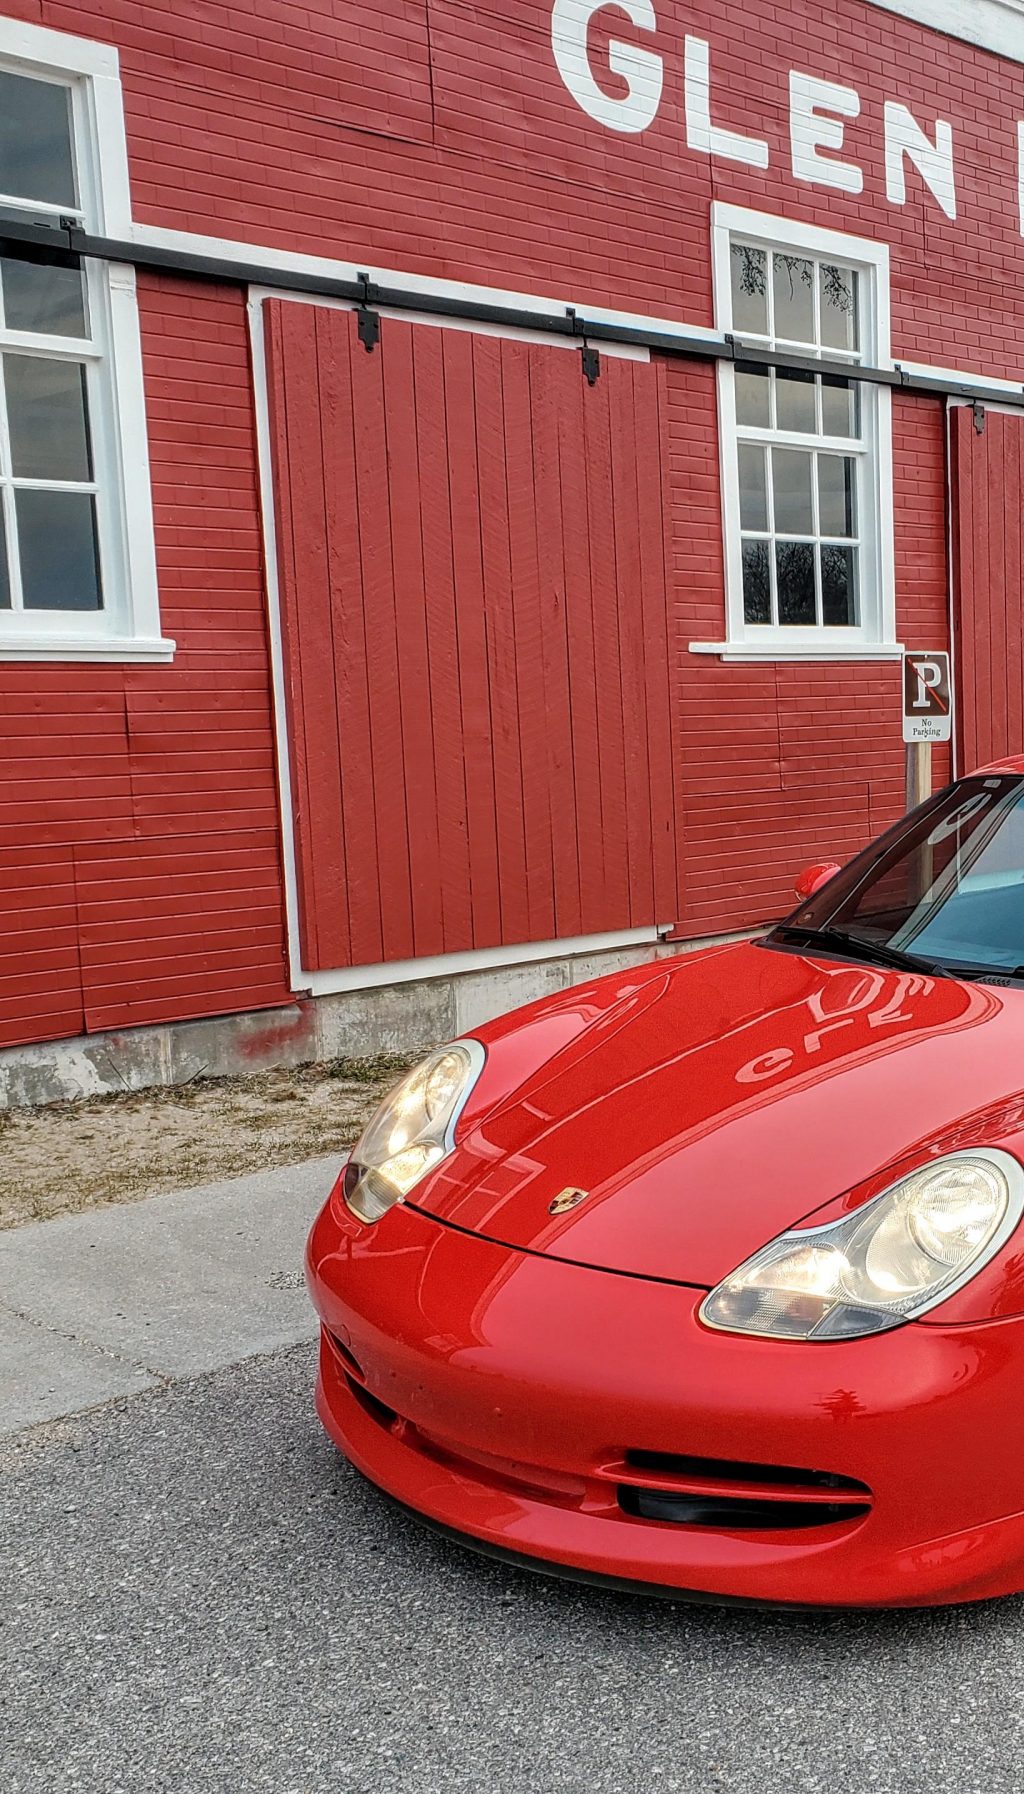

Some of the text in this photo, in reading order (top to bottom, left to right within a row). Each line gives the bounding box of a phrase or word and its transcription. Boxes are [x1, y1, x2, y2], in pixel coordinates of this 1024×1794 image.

[550, 0, 957, 221] GLEN
[912, 662, 941, 707] P
[912, 727, 941, 737] Parking
[921, 718, 932, 727] No
